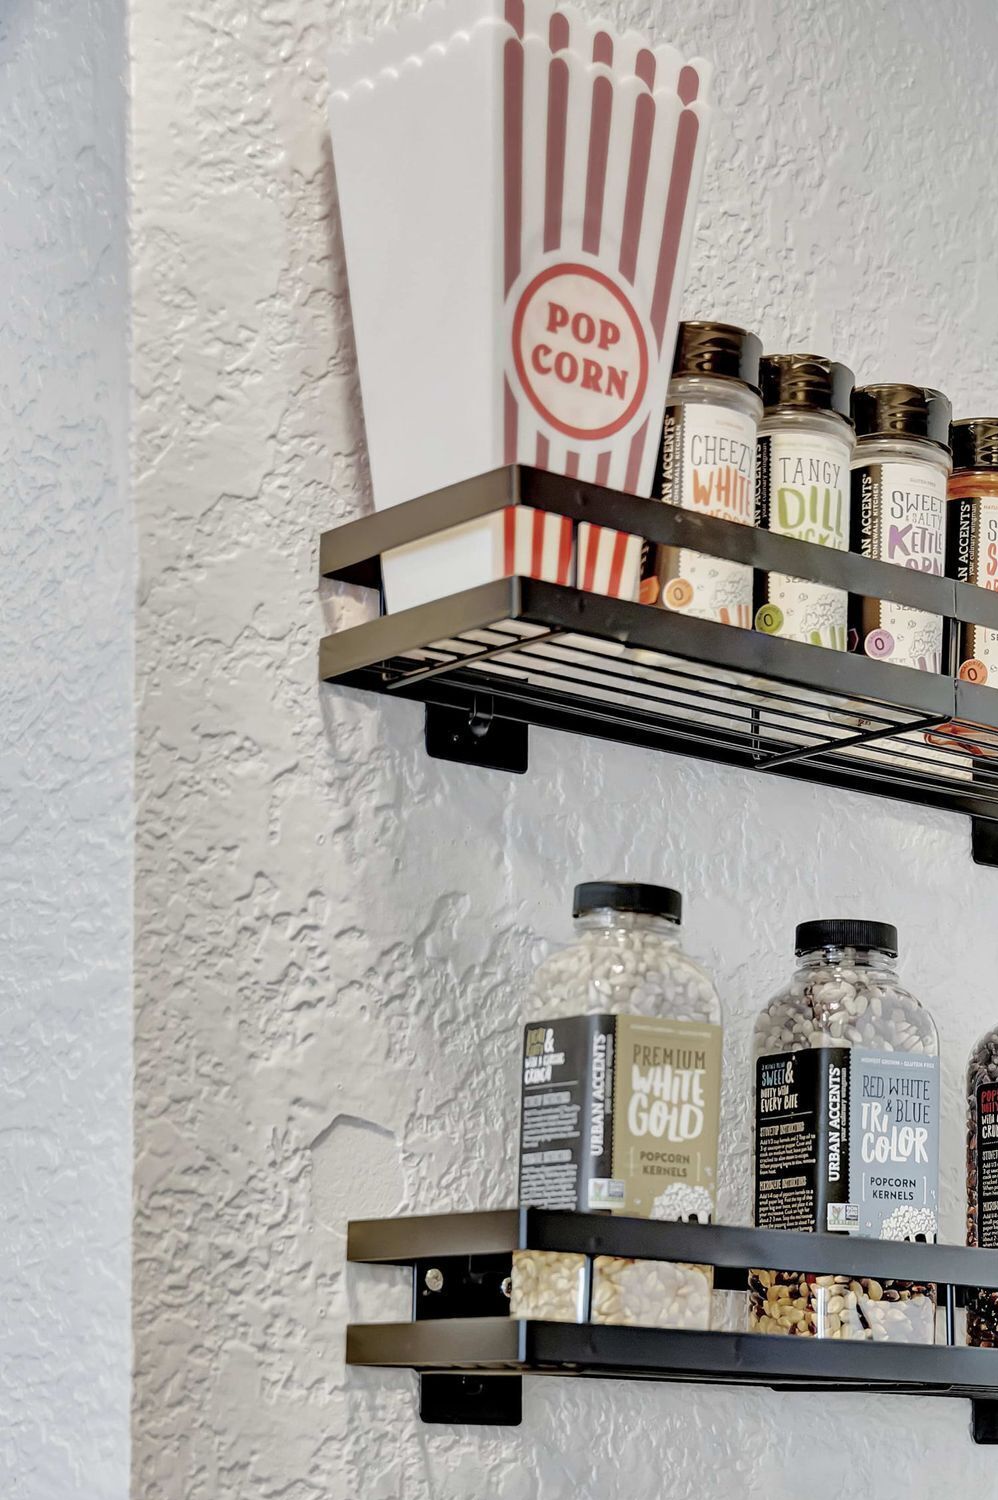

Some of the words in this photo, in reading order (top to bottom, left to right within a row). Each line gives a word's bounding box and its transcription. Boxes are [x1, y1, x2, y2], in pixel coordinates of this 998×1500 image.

[547, 302, 620, 350] POP
[531, 344, 628, 400] CORN
[663, 418, 675, 480] ACCENTS
[693, 465, 752, 517] WHITE
[779, 457, 840, 488] TANGY
[778, 485, 843, 537] DILL
[862, 477, 872, 535] ACCENTS
[891, 490, 943, 519] SWEET
[888, 523, 942, 559] KETTLE
[959, 504, 970, 563] ACCENTS
[632, 1043, 706, 1069] PREMIUM
[632, 1064, 706, 1107] WHITE
[829, 1068, 841, 1130] ACCENTS
[889, 1077, 930, 1100] WHITE
[590, 1102, 604, 1156] URBAN
[627, 1091, 704, 1142] GOLD
[886, 1099, 892, 1112] &
[896, 1099, 930, 1124] BLUE
[639, 1151, 690, 1164] POPCORN
[829, 1131, 840, 1182] URBAN
[862, 1125, 929, 1164] COLOR
[642, 1165, 688, 1177] KERNELS
[870, 1177, 916, 1188] POPCORN
[872, 1190, 914, 1200] KERNELS
